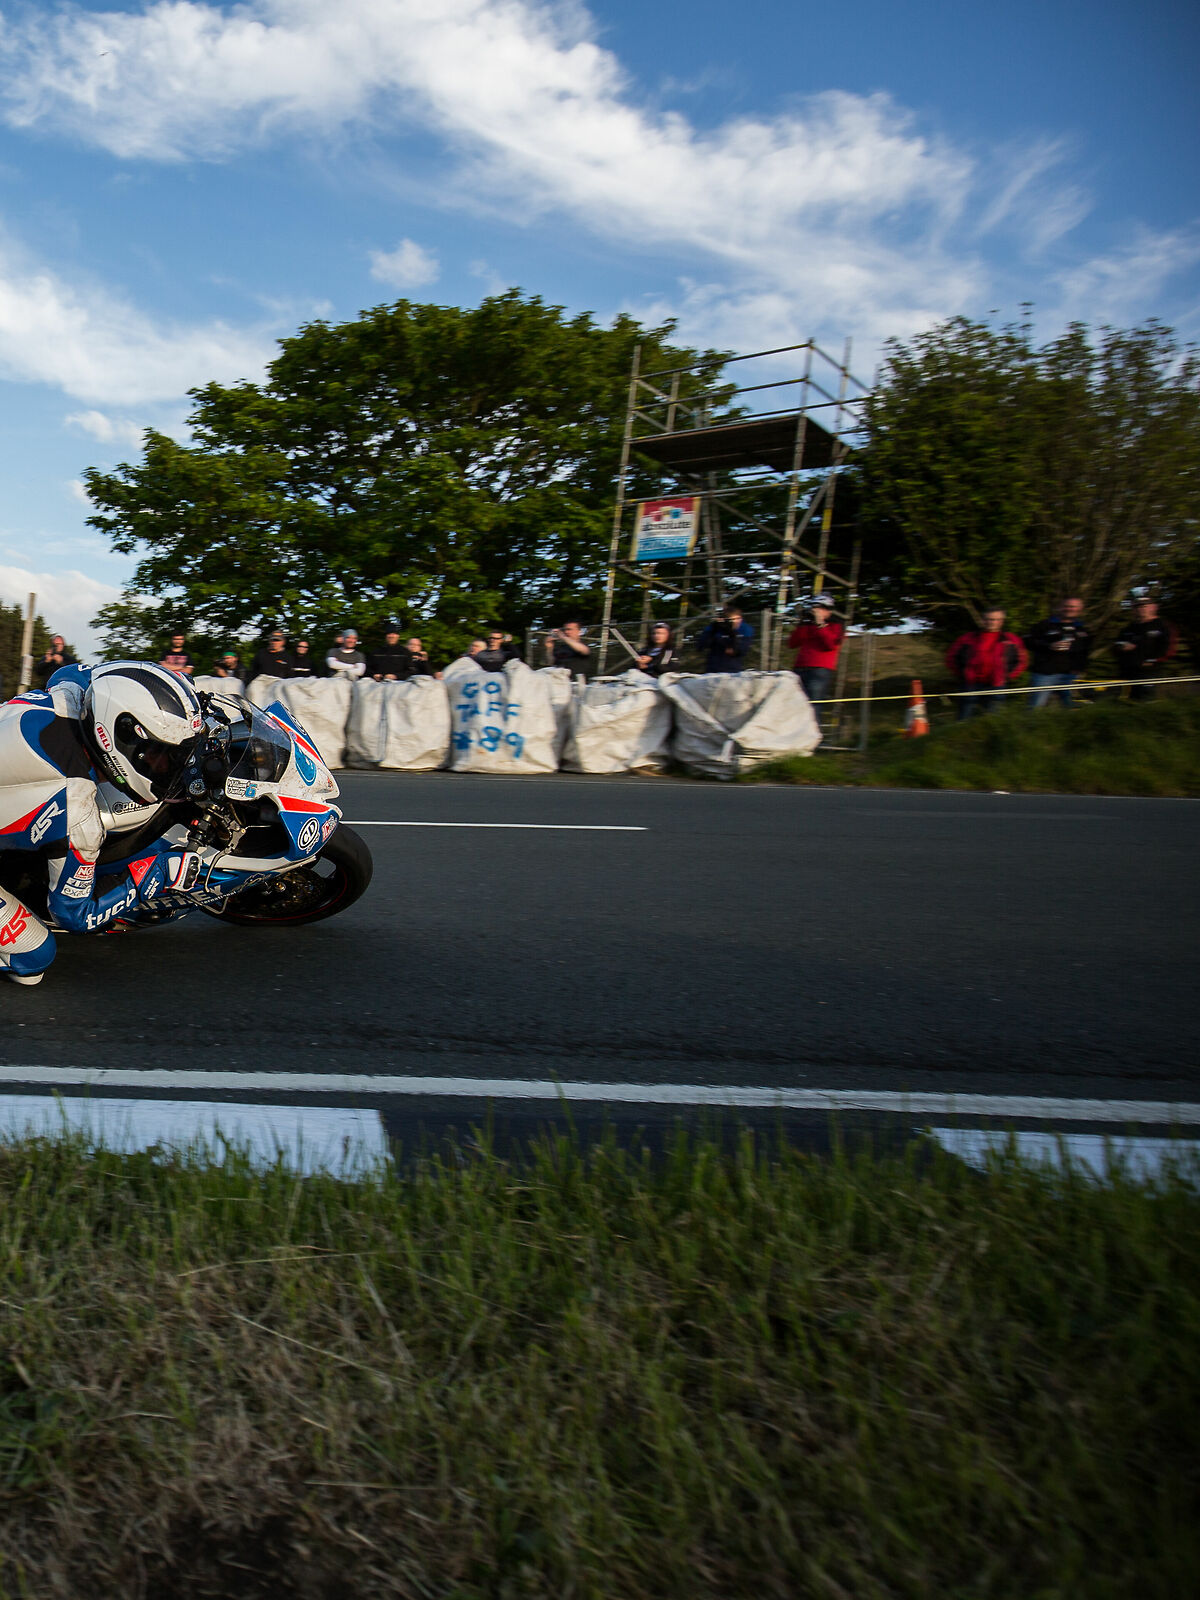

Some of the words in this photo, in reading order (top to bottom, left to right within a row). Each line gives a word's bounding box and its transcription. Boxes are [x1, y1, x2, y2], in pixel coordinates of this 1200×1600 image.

[462, 681, 502, 698] GO
[456, 701, 522, 722] TAFF
[96, 726, 111, 750] BELL
[245, 783, 258, 798] 6
[30, 801, 66, 845] 45
[301, 820, 316, 846] CD
[85, 888, 137, 930] tyco
